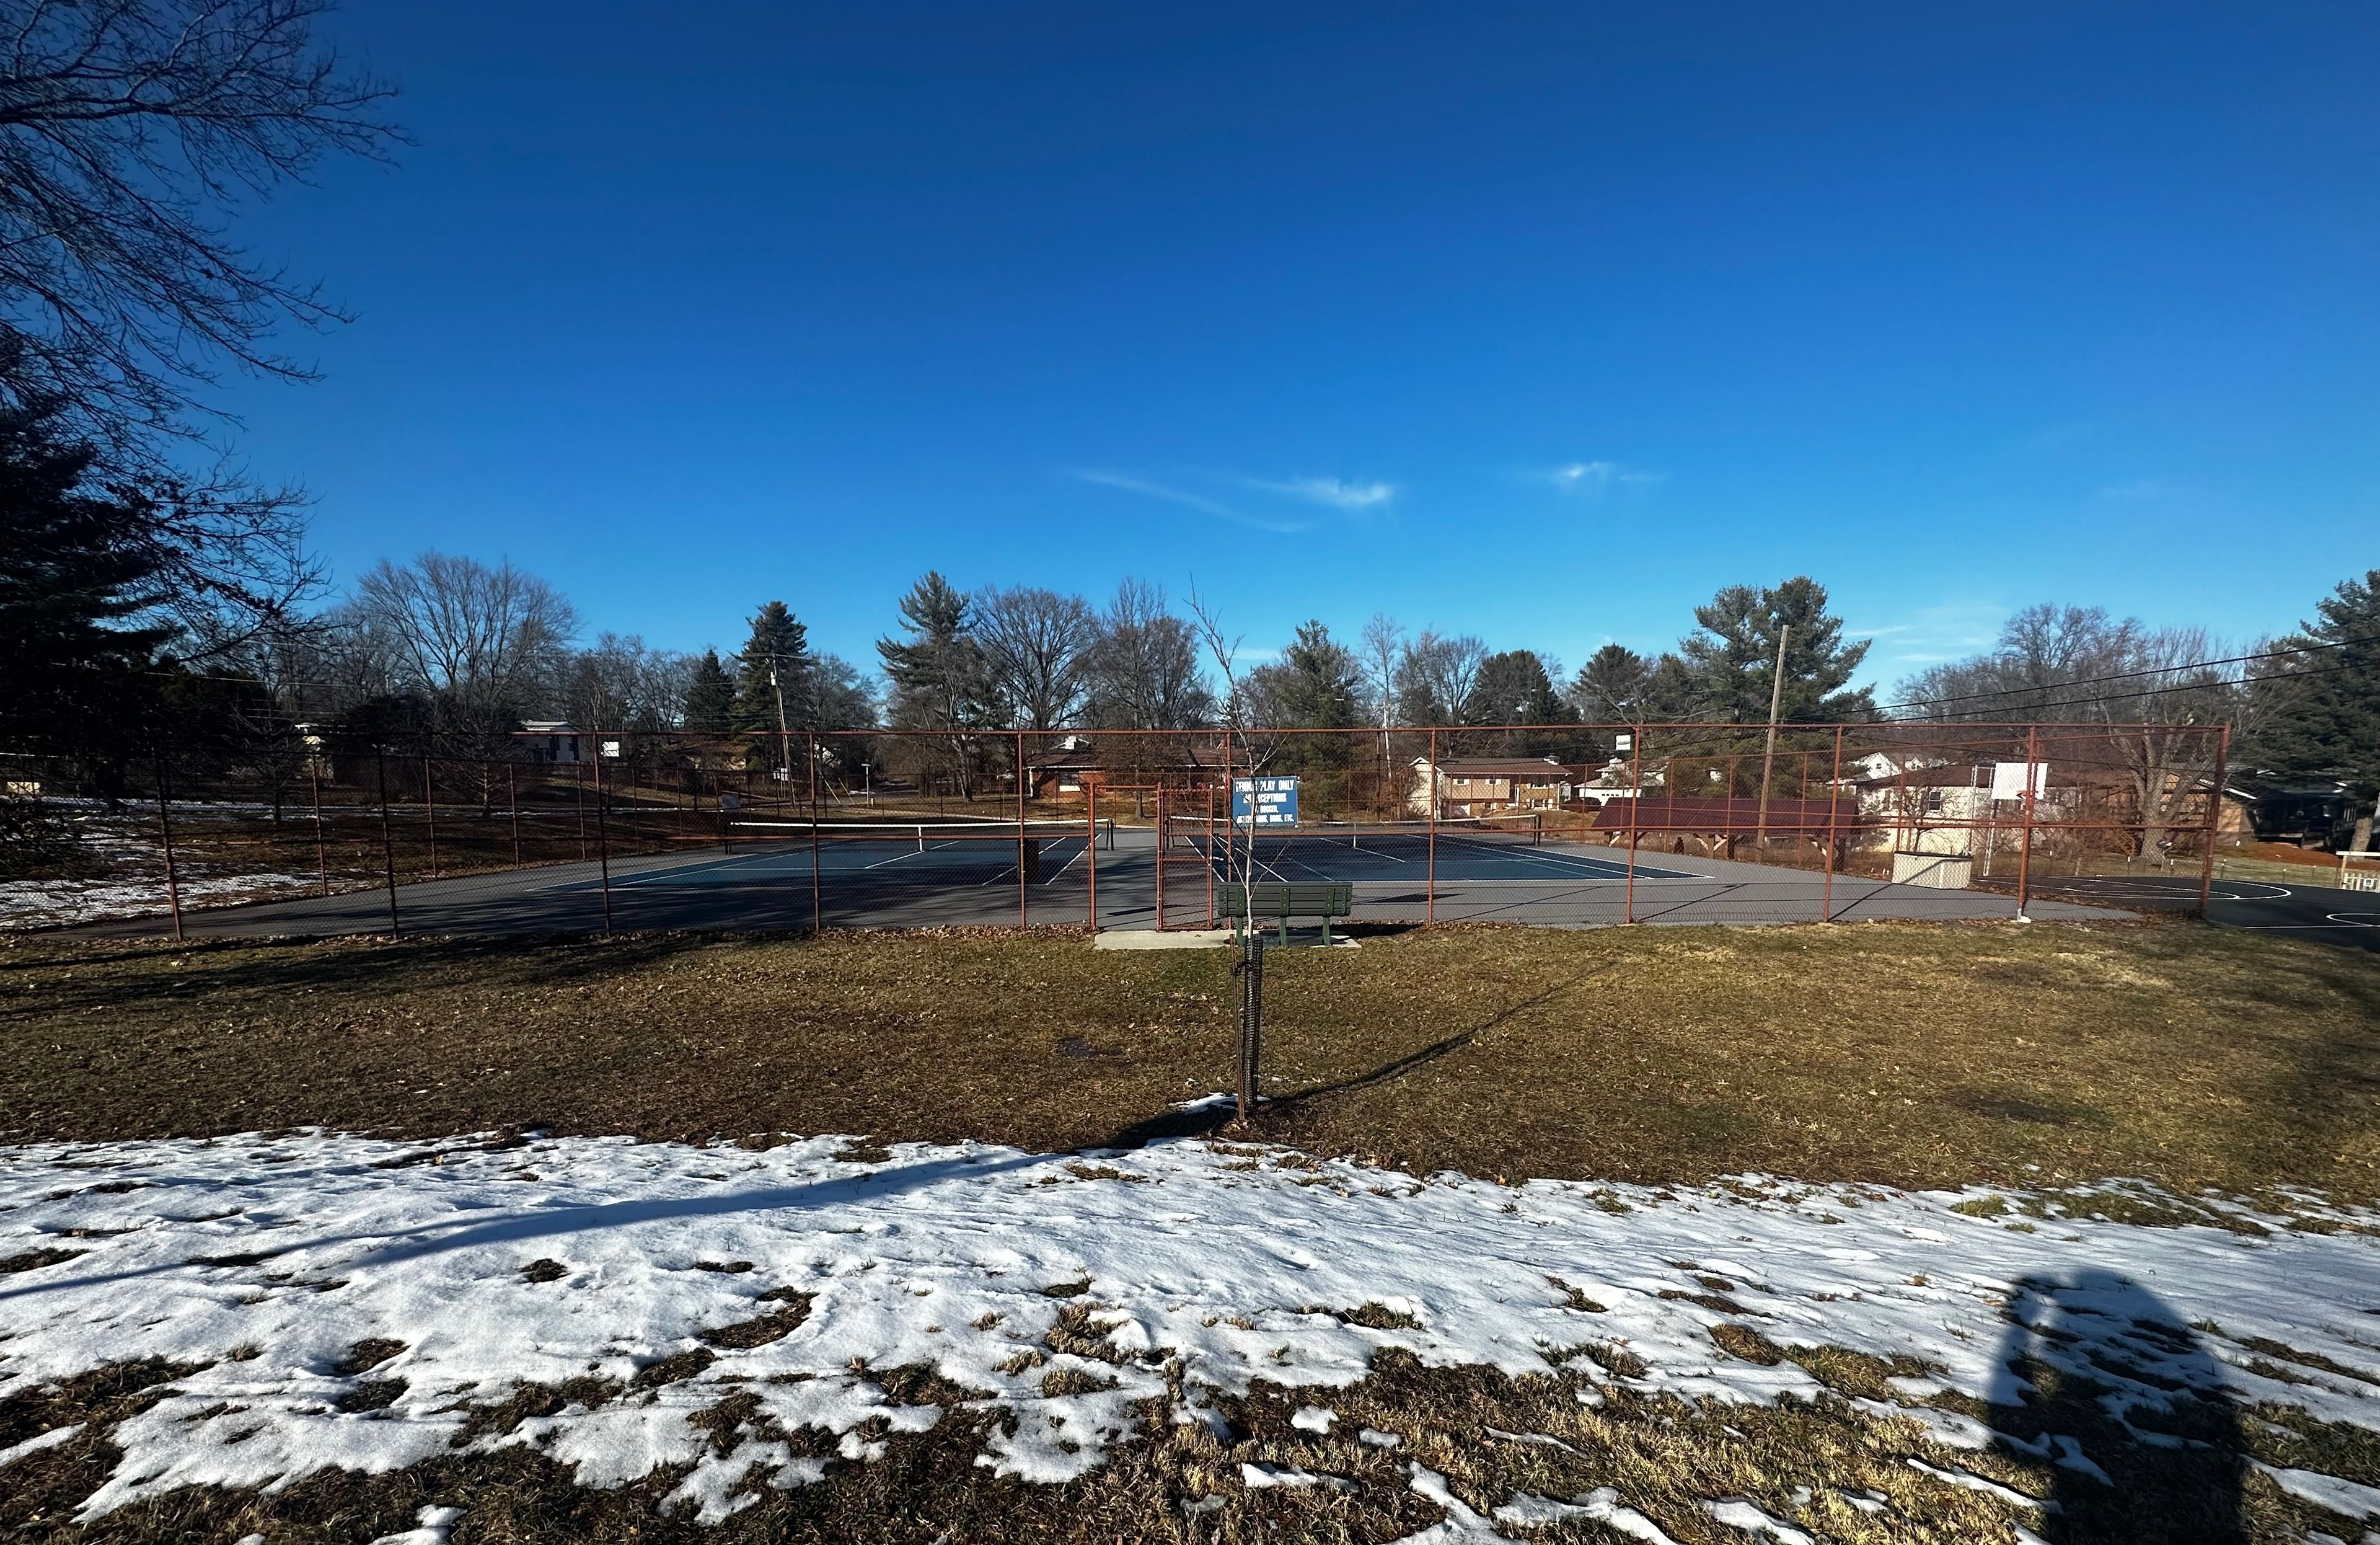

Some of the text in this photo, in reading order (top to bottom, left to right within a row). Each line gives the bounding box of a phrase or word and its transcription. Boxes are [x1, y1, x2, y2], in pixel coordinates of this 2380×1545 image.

[1260, 780, 1276, 792] PLAY
[1278, 779, 1294, 790] ONLY
[1255, 793, 1287, 803] XCEPTIONS
